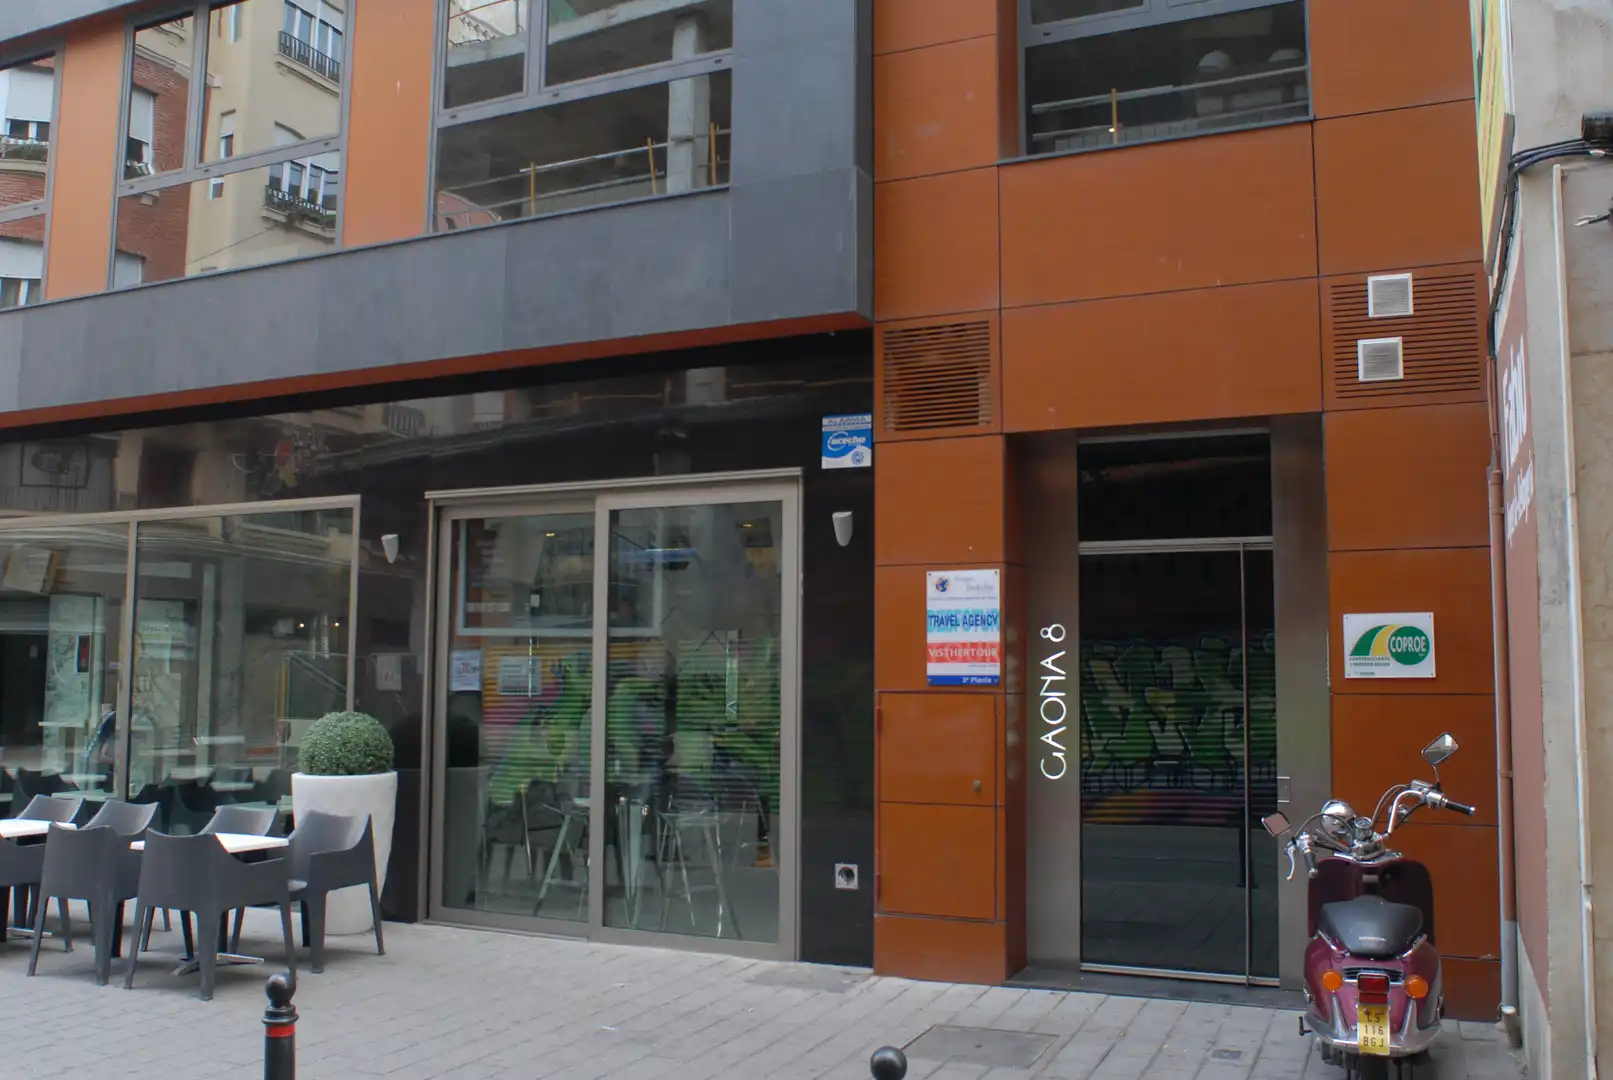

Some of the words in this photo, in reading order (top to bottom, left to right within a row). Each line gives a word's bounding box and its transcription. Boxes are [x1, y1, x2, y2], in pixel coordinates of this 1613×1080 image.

[928, 614, 960, 627] TRAVEL
[962, 613, 999, 627] AGENCY
[1040, 623, 1067, 643] 8
[1390, 636, 1426, 652] COPROE
[1040, 651, 1067, 779] GAONA
[1364, 1025, 1384, 1035] 116
[1363, 1037, 1384, 1047] BGJ
